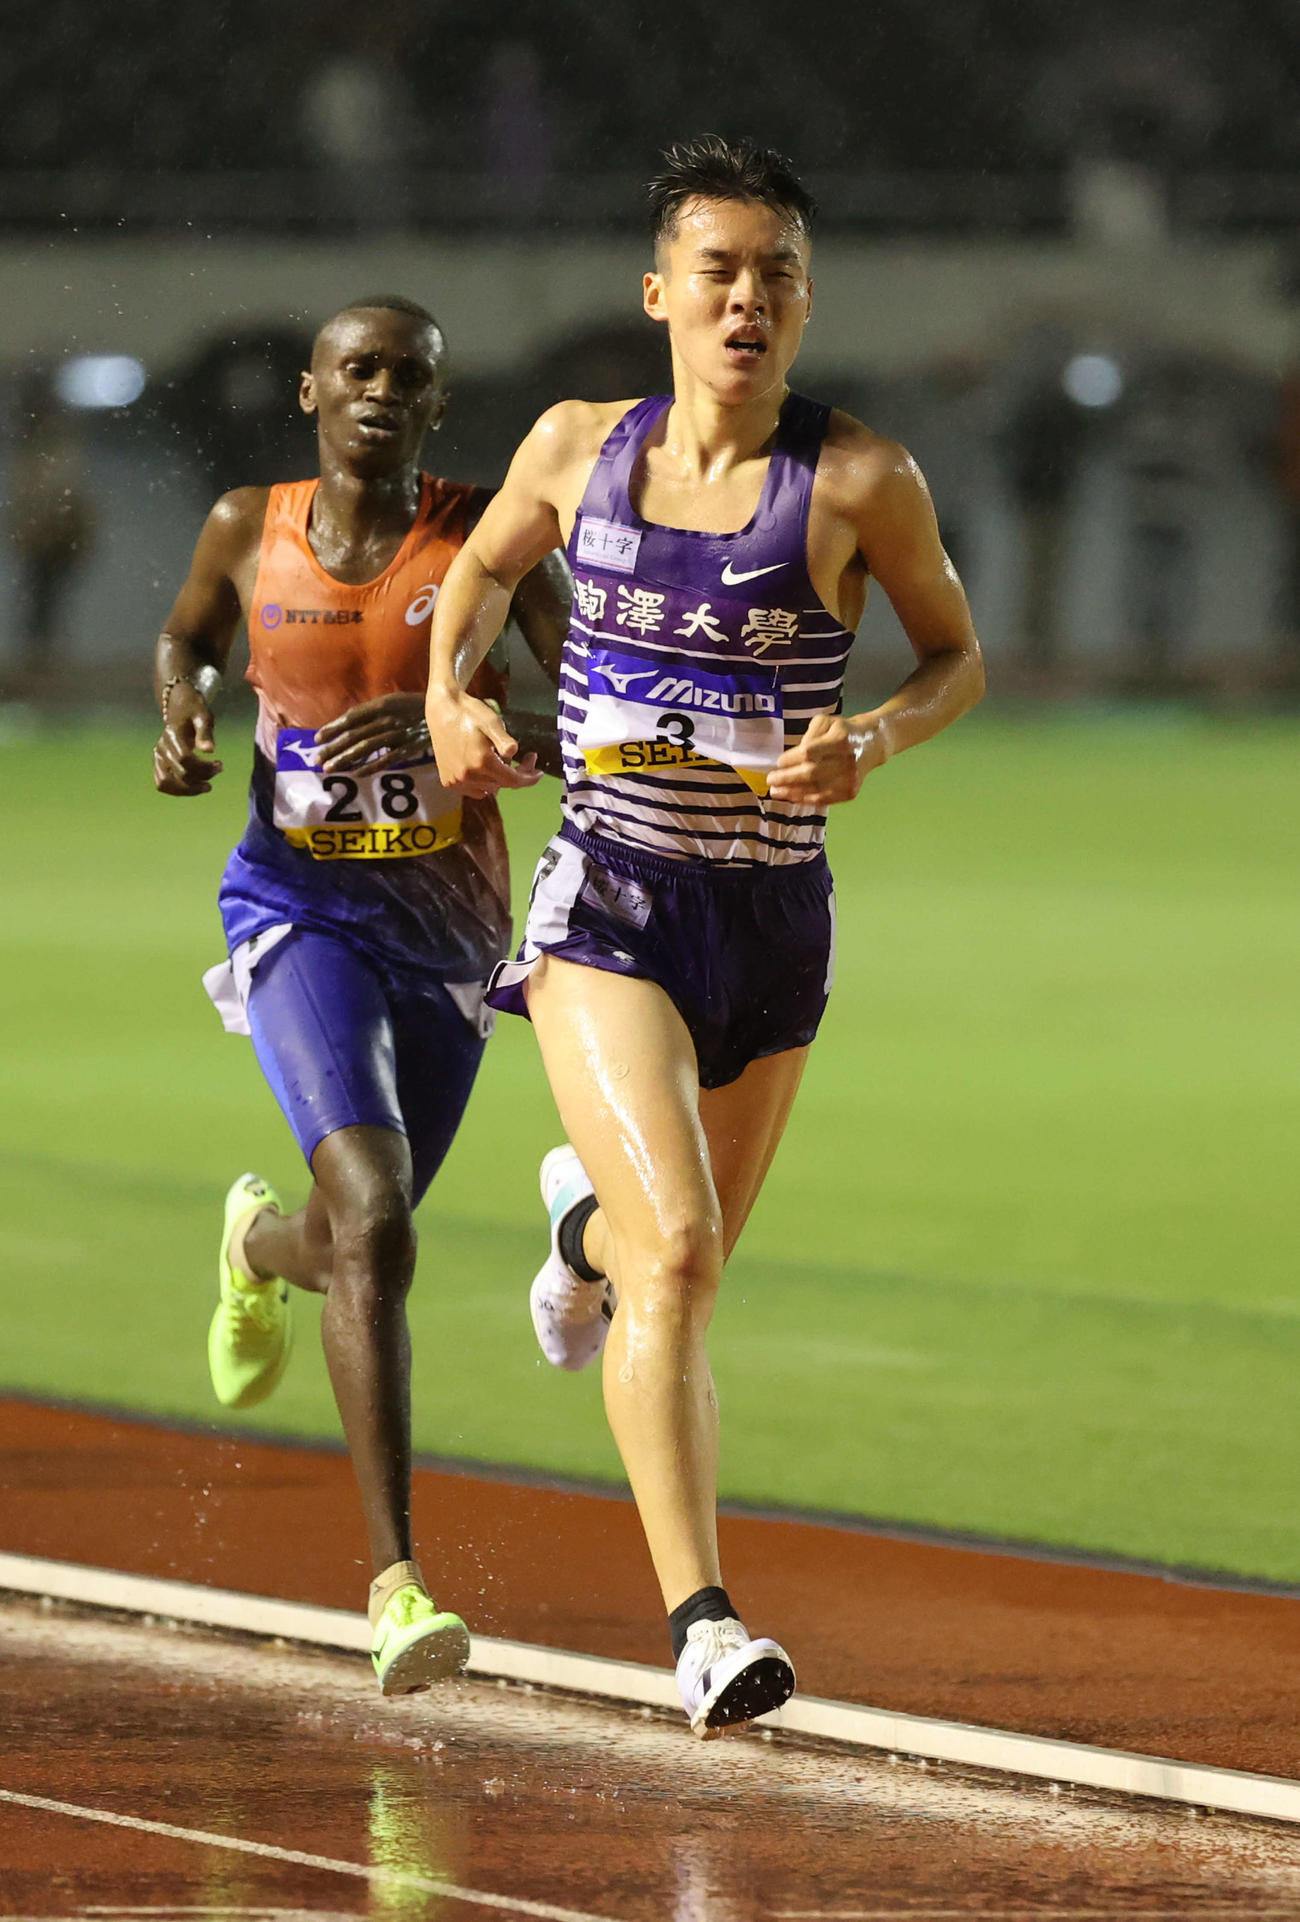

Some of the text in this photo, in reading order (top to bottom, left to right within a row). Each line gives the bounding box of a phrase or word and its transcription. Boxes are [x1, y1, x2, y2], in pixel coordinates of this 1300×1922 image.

[583, 529, 634, 555] 桜十字
[656, 712, 696, 751] 3
[322, 773, 419, 823] 28
[311, 824, 437, 856] SEIKO
